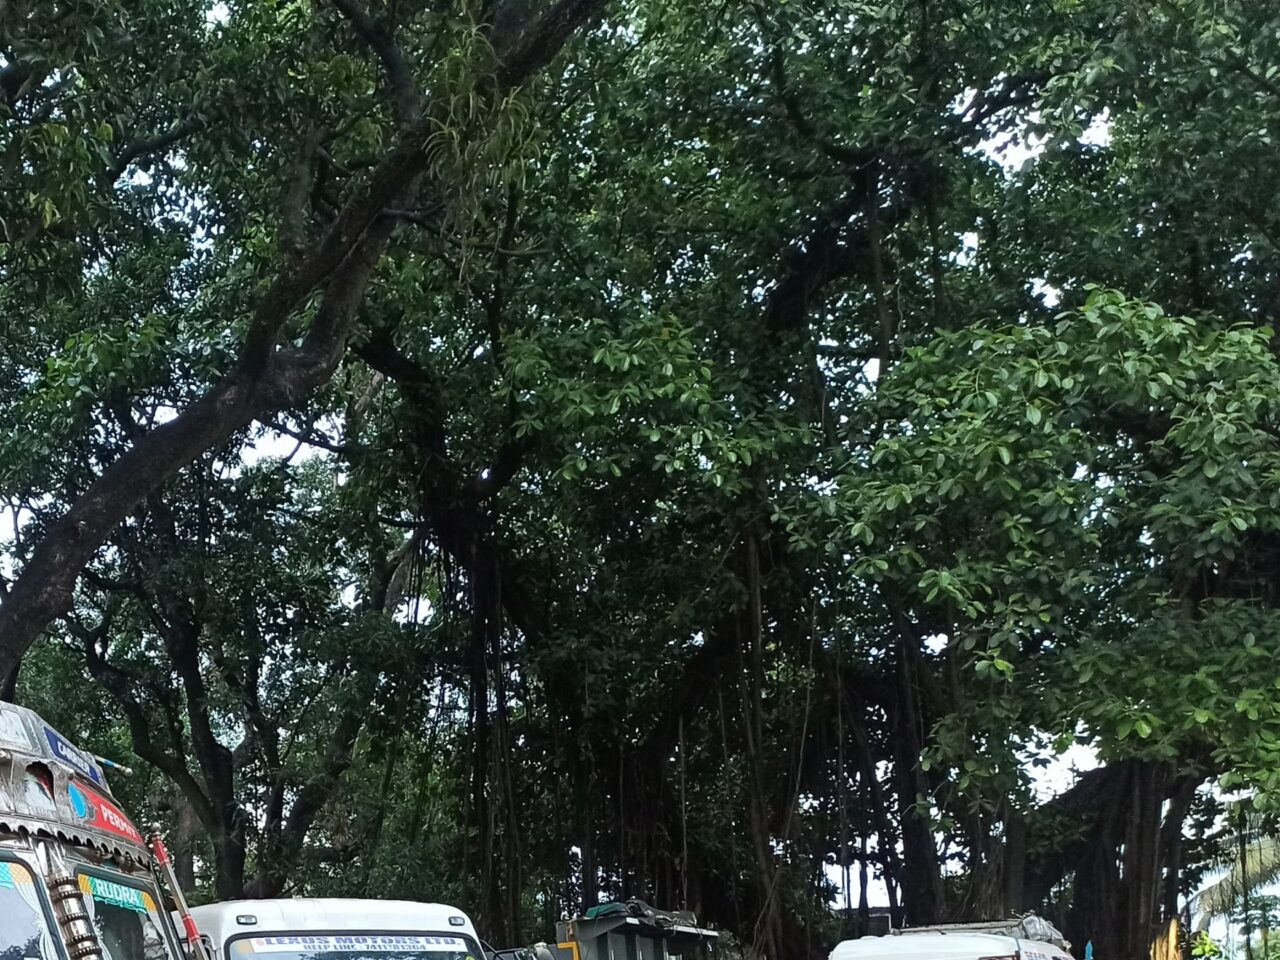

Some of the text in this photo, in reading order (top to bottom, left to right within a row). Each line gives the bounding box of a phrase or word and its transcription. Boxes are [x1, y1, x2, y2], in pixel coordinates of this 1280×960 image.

[57, 741, 92, 774] CARRIER
[100, 803, 138, 838] PERMIT
[96, 882, 139, 903] RUDRA
[265, 936, 330, 945] LEXUS
[335, 936, 421, 945] MOTORS
